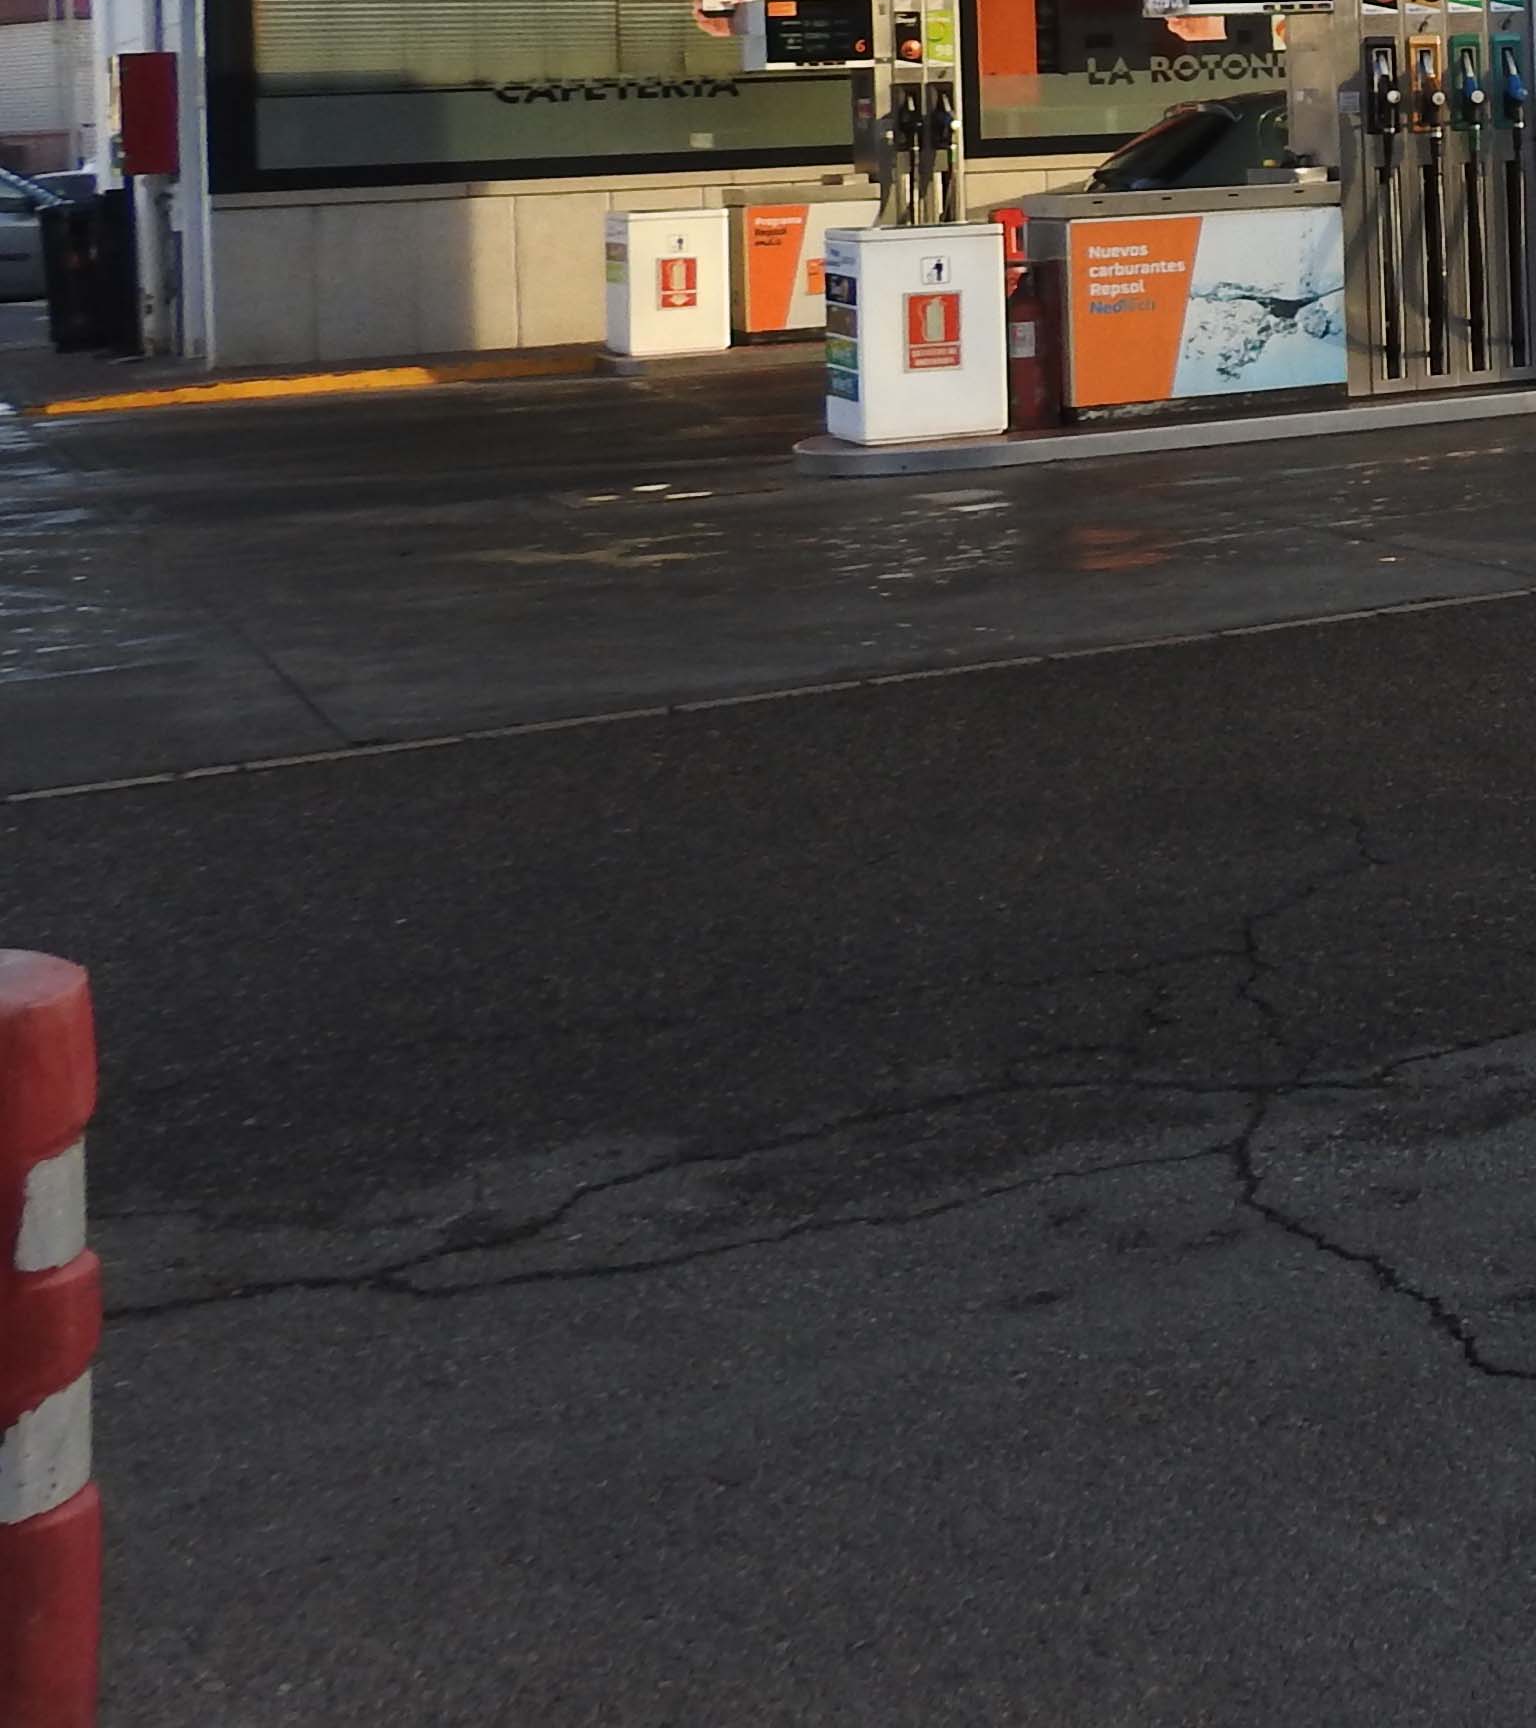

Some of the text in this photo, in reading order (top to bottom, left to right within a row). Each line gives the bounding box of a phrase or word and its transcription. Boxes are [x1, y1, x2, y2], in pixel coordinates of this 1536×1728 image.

[855, 39, 866, 53] 6
[1087, 57, 1135, 85] LA
[1088, 245, 1149, 259] Nuevos
[1088, 261, 1186, 278] carburantes
[1089, 279, 1145, 298] Repsol
